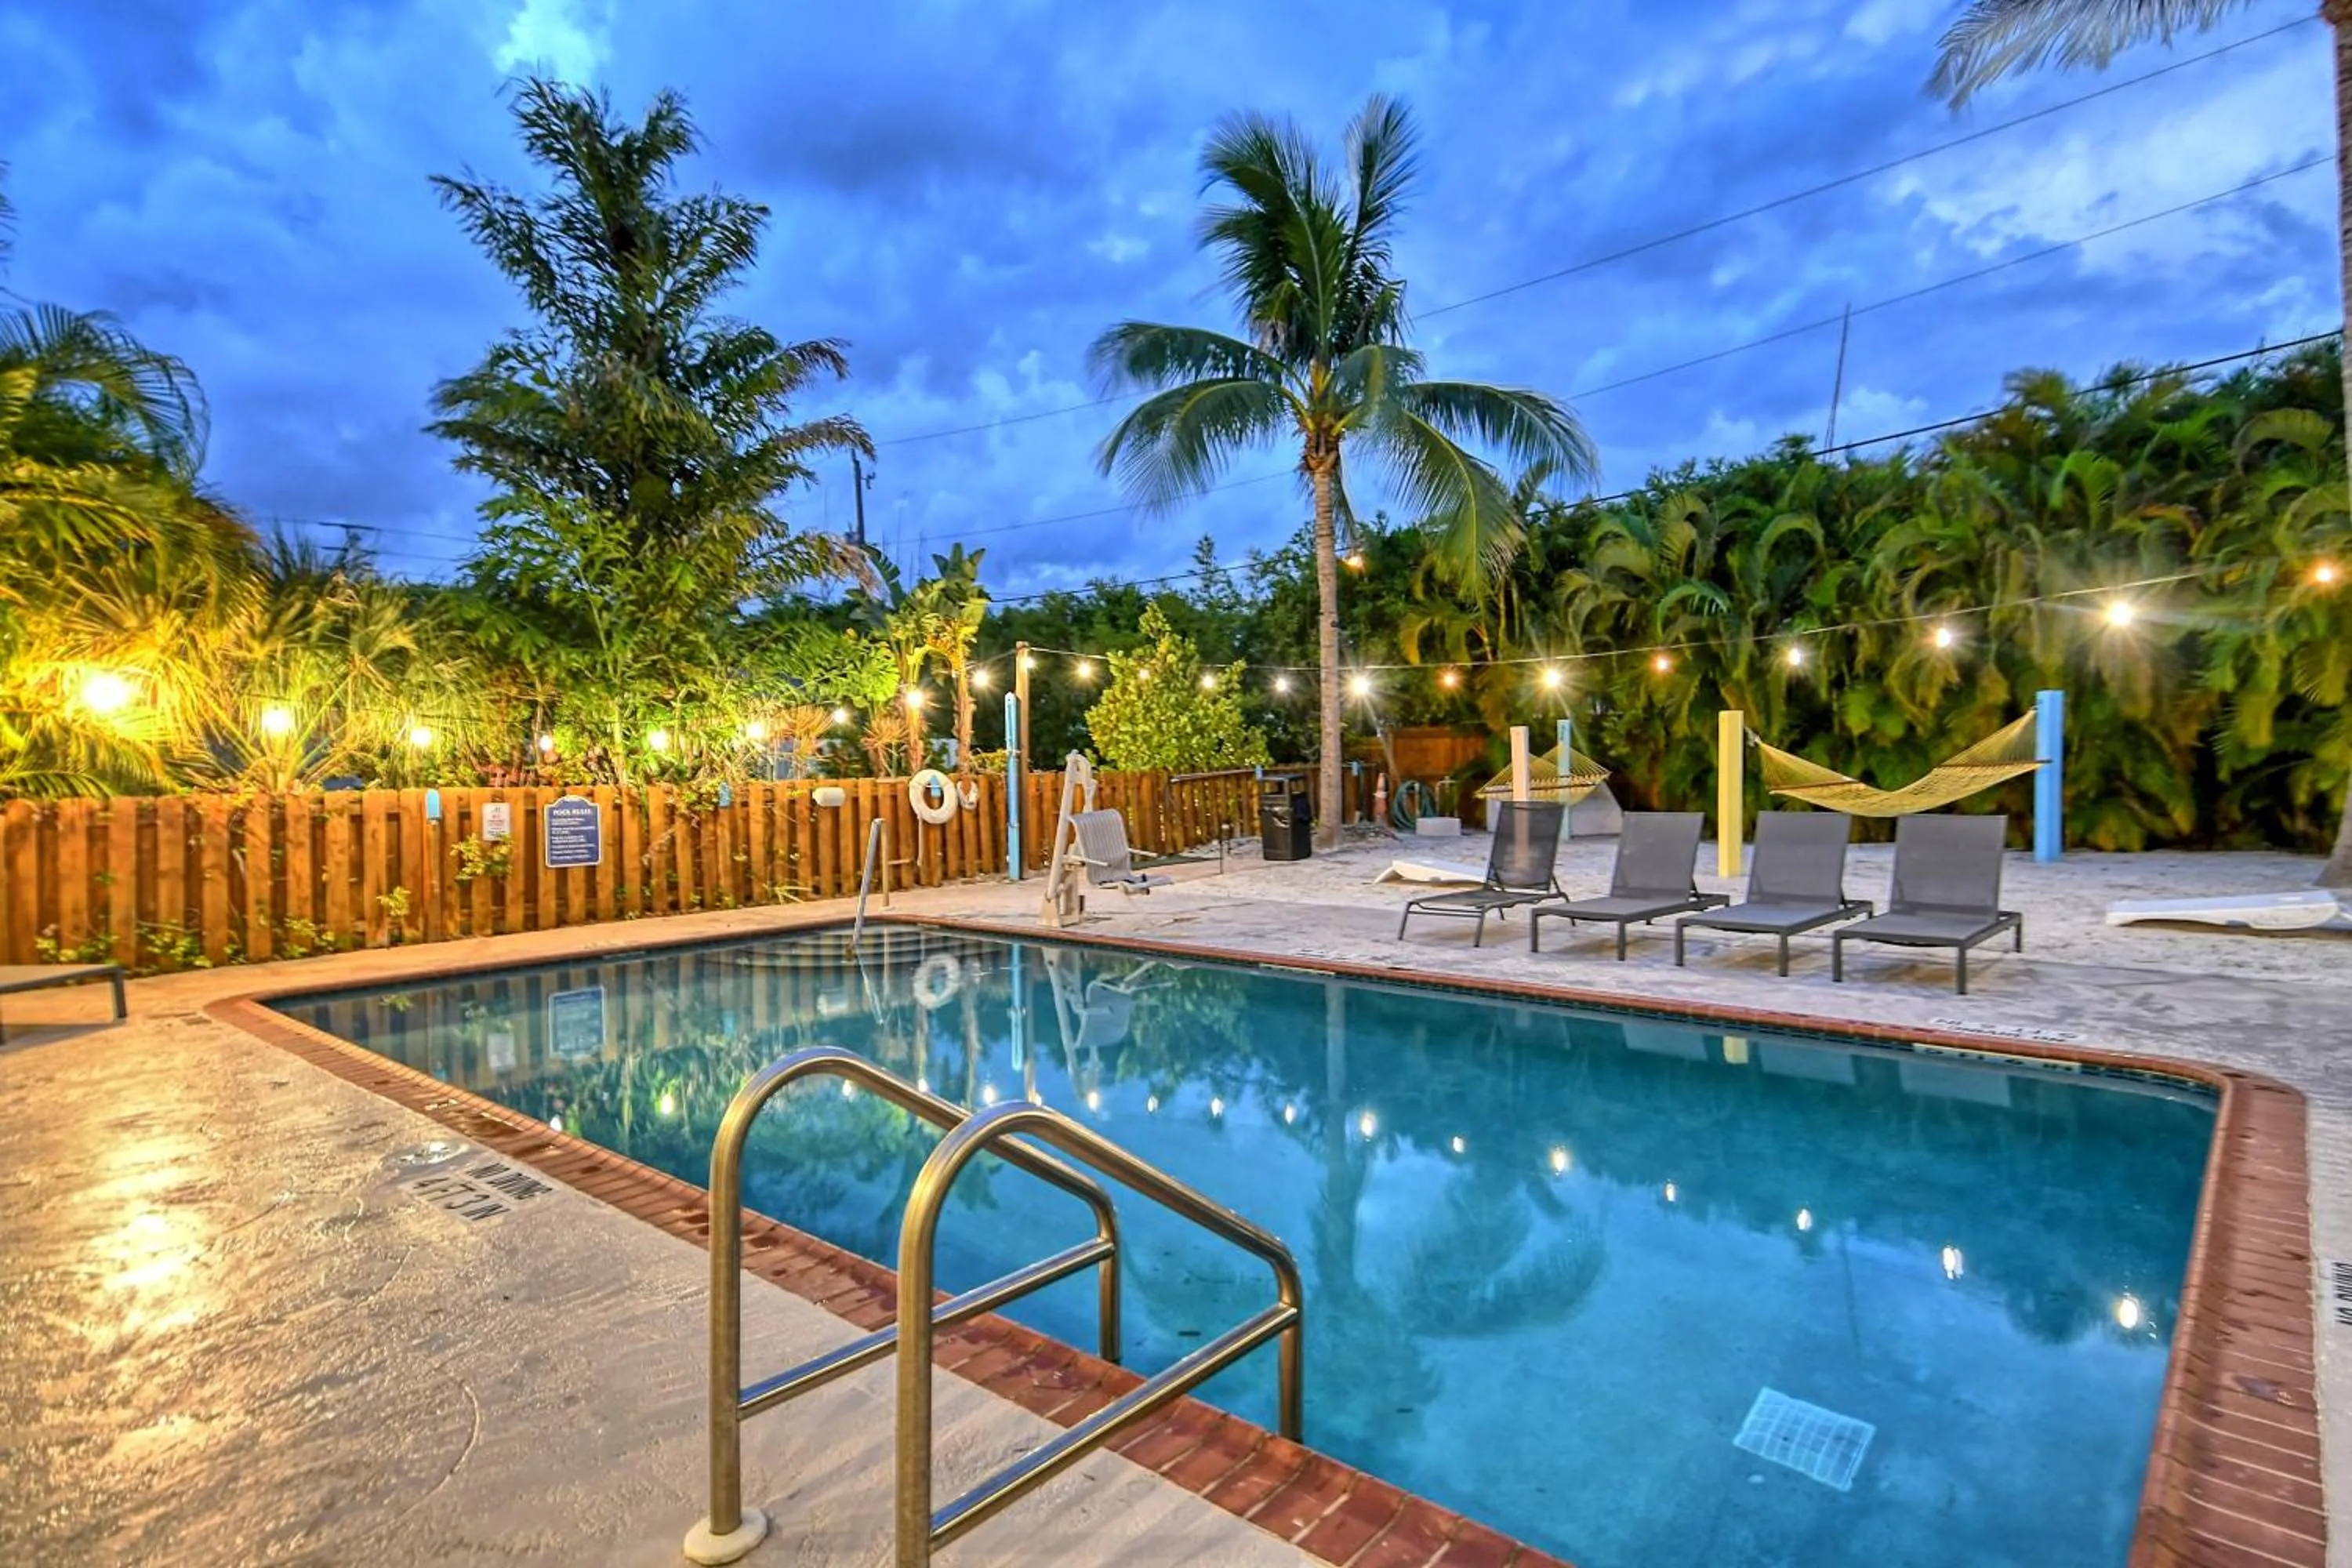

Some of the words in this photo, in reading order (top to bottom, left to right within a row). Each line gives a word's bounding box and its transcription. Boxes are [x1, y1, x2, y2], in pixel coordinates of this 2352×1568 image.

[467, 1162, 510, 1179] NO
[413, 1177, 450, 1190] 4
[416, 1182, 477, 1202] FT
[485, 1173, 553, 1200] DIVING
[443, 1193, 490, 1210] 3
[461, 1203, 512, 1221] IN
